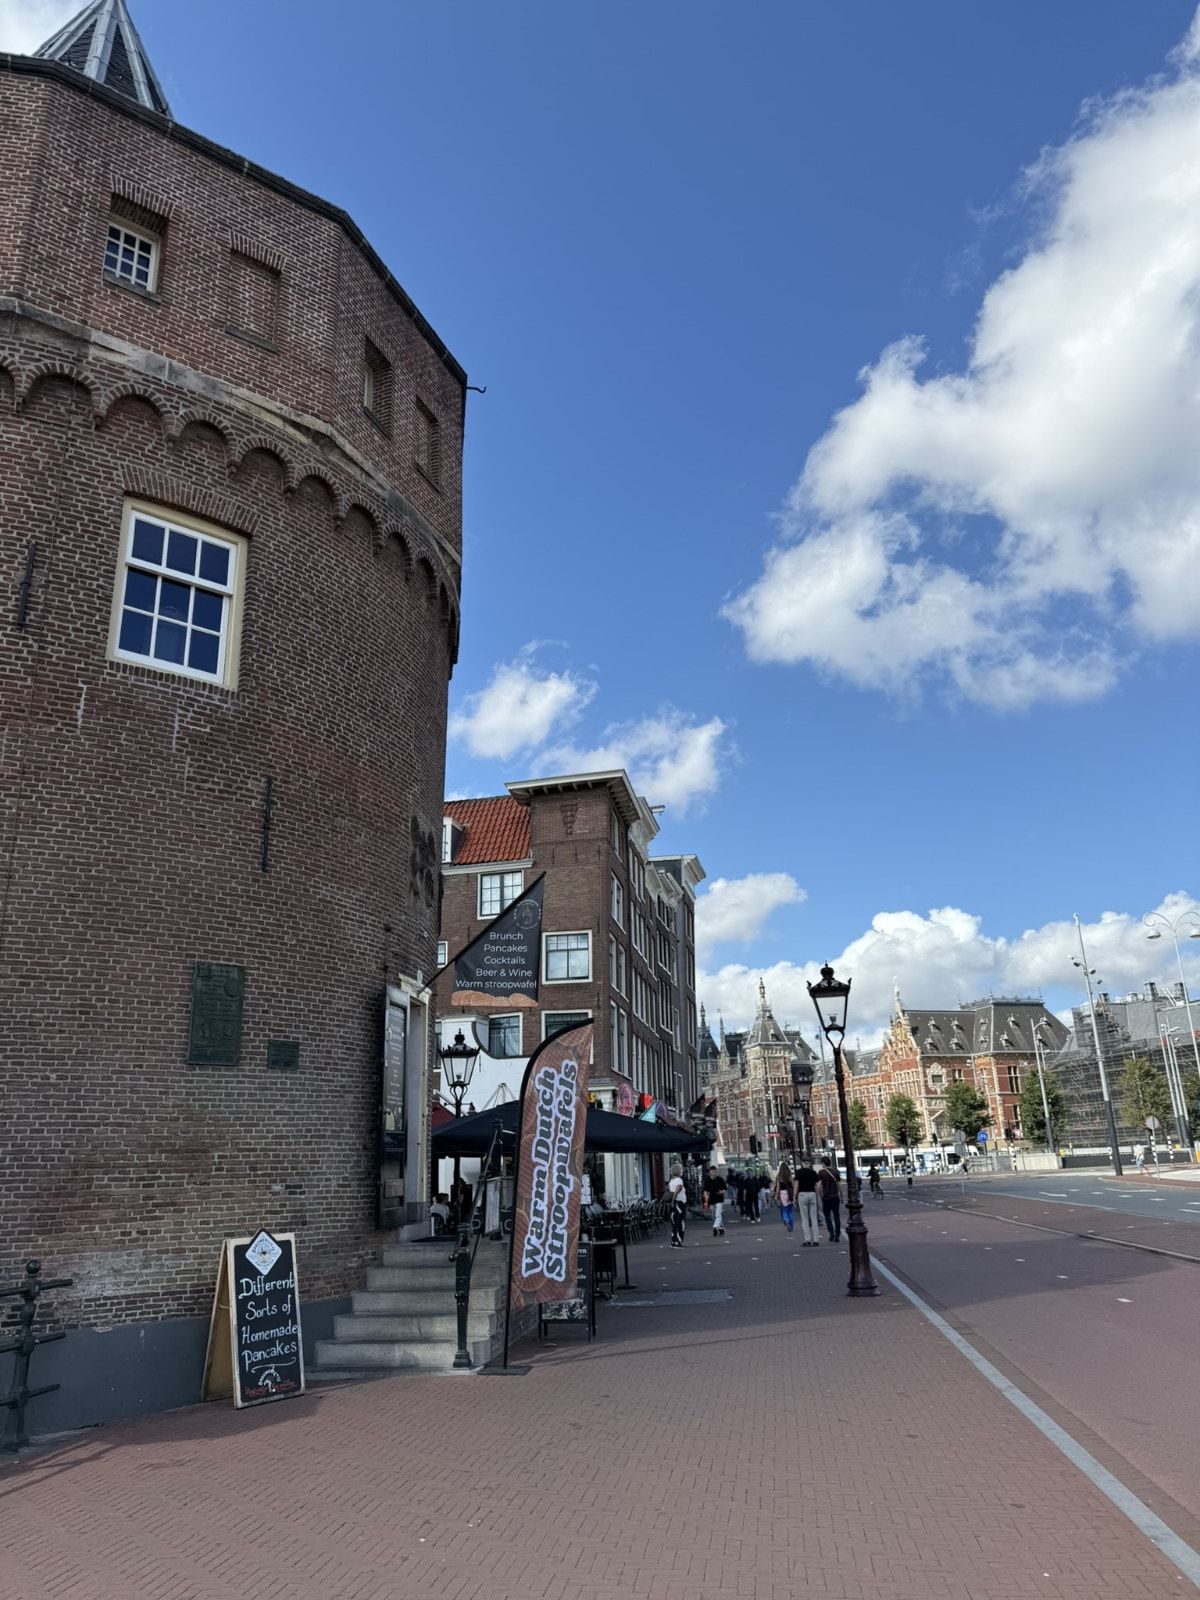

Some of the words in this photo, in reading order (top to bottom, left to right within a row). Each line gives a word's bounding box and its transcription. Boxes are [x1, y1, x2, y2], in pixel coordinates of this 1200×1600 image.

[484, 944, 528, 952] Pancakes
[489, 932, 524, 940] Brunch
[476, 968, 497, 977] Beer
[499, 968, 507, 977] &
[509, 968, 533, 977] Wine
[484, 956, 526, 965] Cocktails
[456, 980, 483, 989] Warm
[485, 980, 537, 990] stroopwafel
[533, 1068, 557, 1167] Dutch
[545, 1061, 577, 1279] Stroopwafels
[523, 1167, 548, 1276] Warm
[238, 1272, 296, 1299] Different
[245, 1298, 278, 1320] Sorts
[281, 1294, 292, 1316] of
[241, 1319, 298, 1345] Homemade
